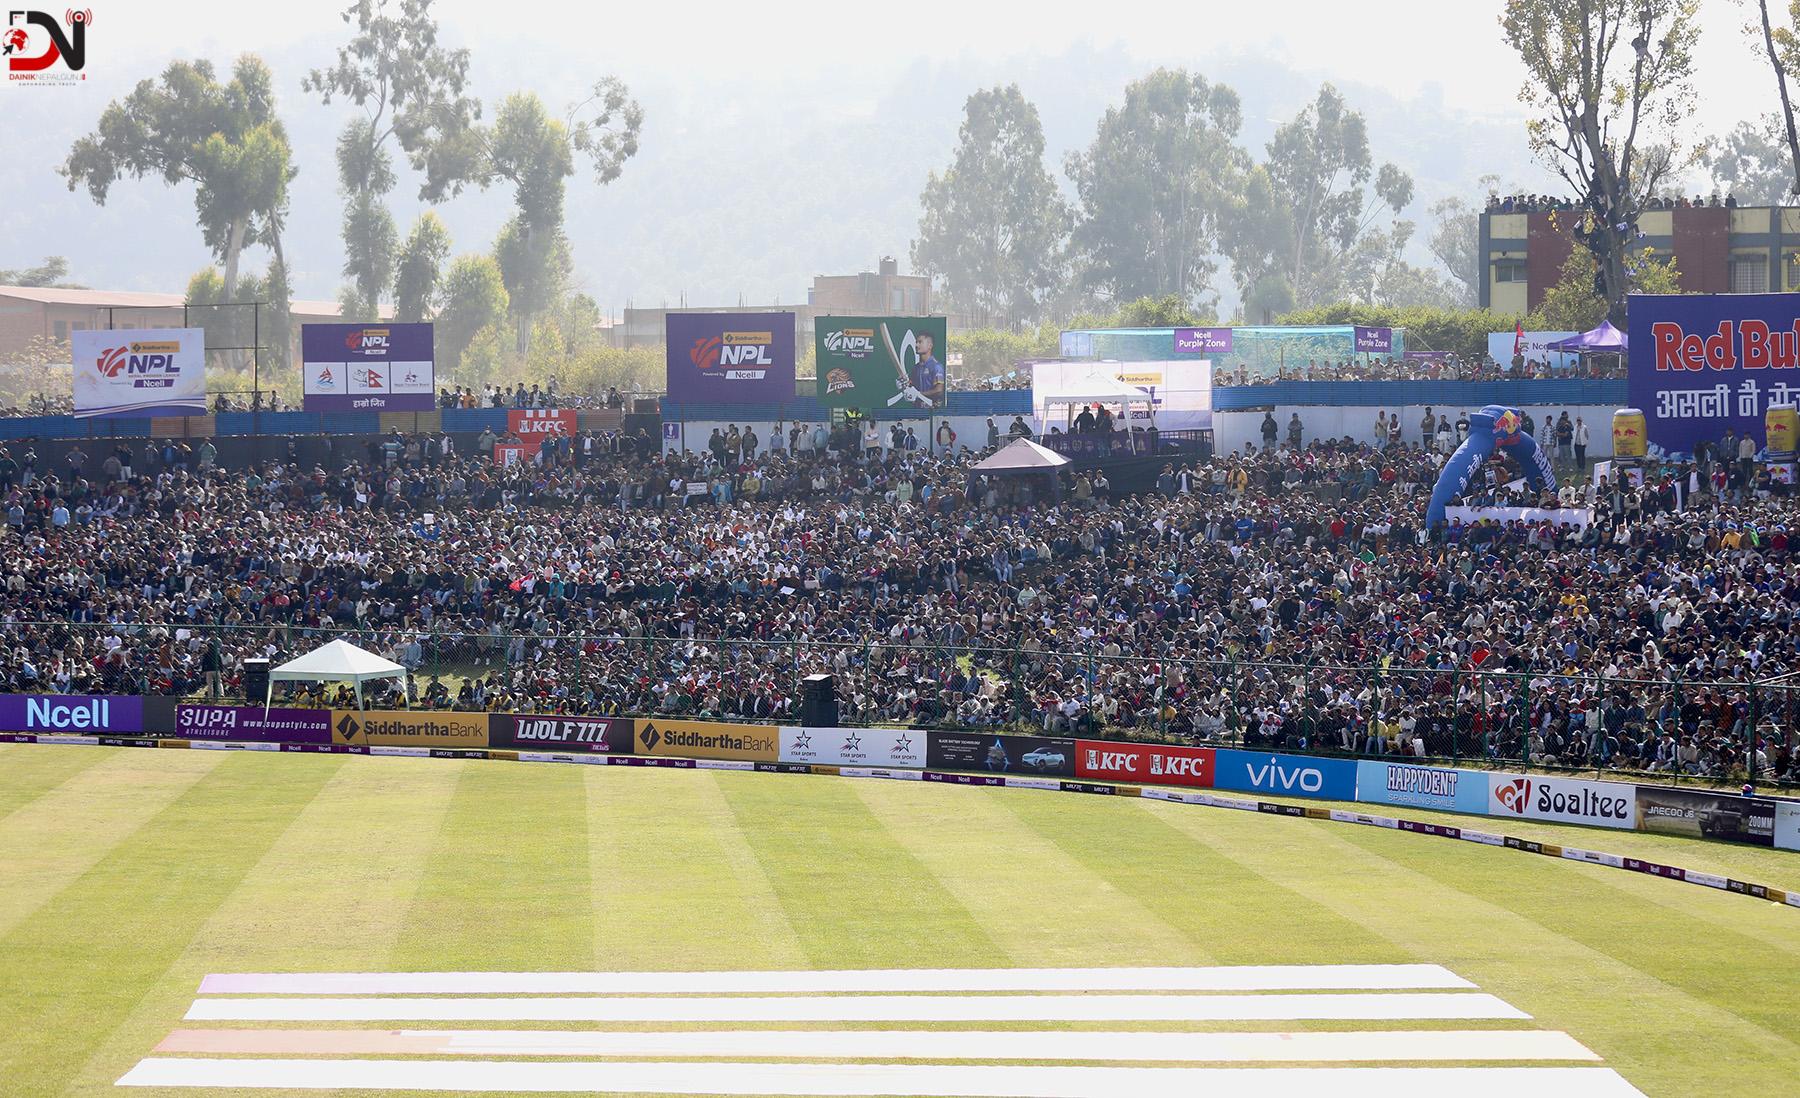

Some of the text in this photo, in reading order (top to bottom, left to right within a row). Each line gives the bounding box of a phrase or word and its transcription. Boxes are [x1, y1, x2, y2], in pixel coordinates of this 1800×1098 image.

[361, 337, 390, 347] NPL
[842, 337, 874, 349] NPL
[1179, 339, 1226, 349] Purple Zone
[1193, 331, 1211, 339] Ncell
[1375, 339, 1388, 348] Zone
[720, 346, 772, 364] NPL
[1652, 320, 1736, 371] Red
[128, 354, 180, 373] NPL
[1657, 384, 1731, 418] असली
[532, 420, 566, 433] KFC
[27, 698, 109, 728] Ncell
[180, 708, 236, 728] SUPA
[243, 719, 328, 730] www.supastyle.com
[1100, 752, 1138, 772] KFC
[1164, 757, 1203, 777] KFC
[1246, 757, 1322, 791] vivo
[1387, 766, 1458, 797] HAPPYDENT
[1538, 784, 1627, 819] Soaltee
